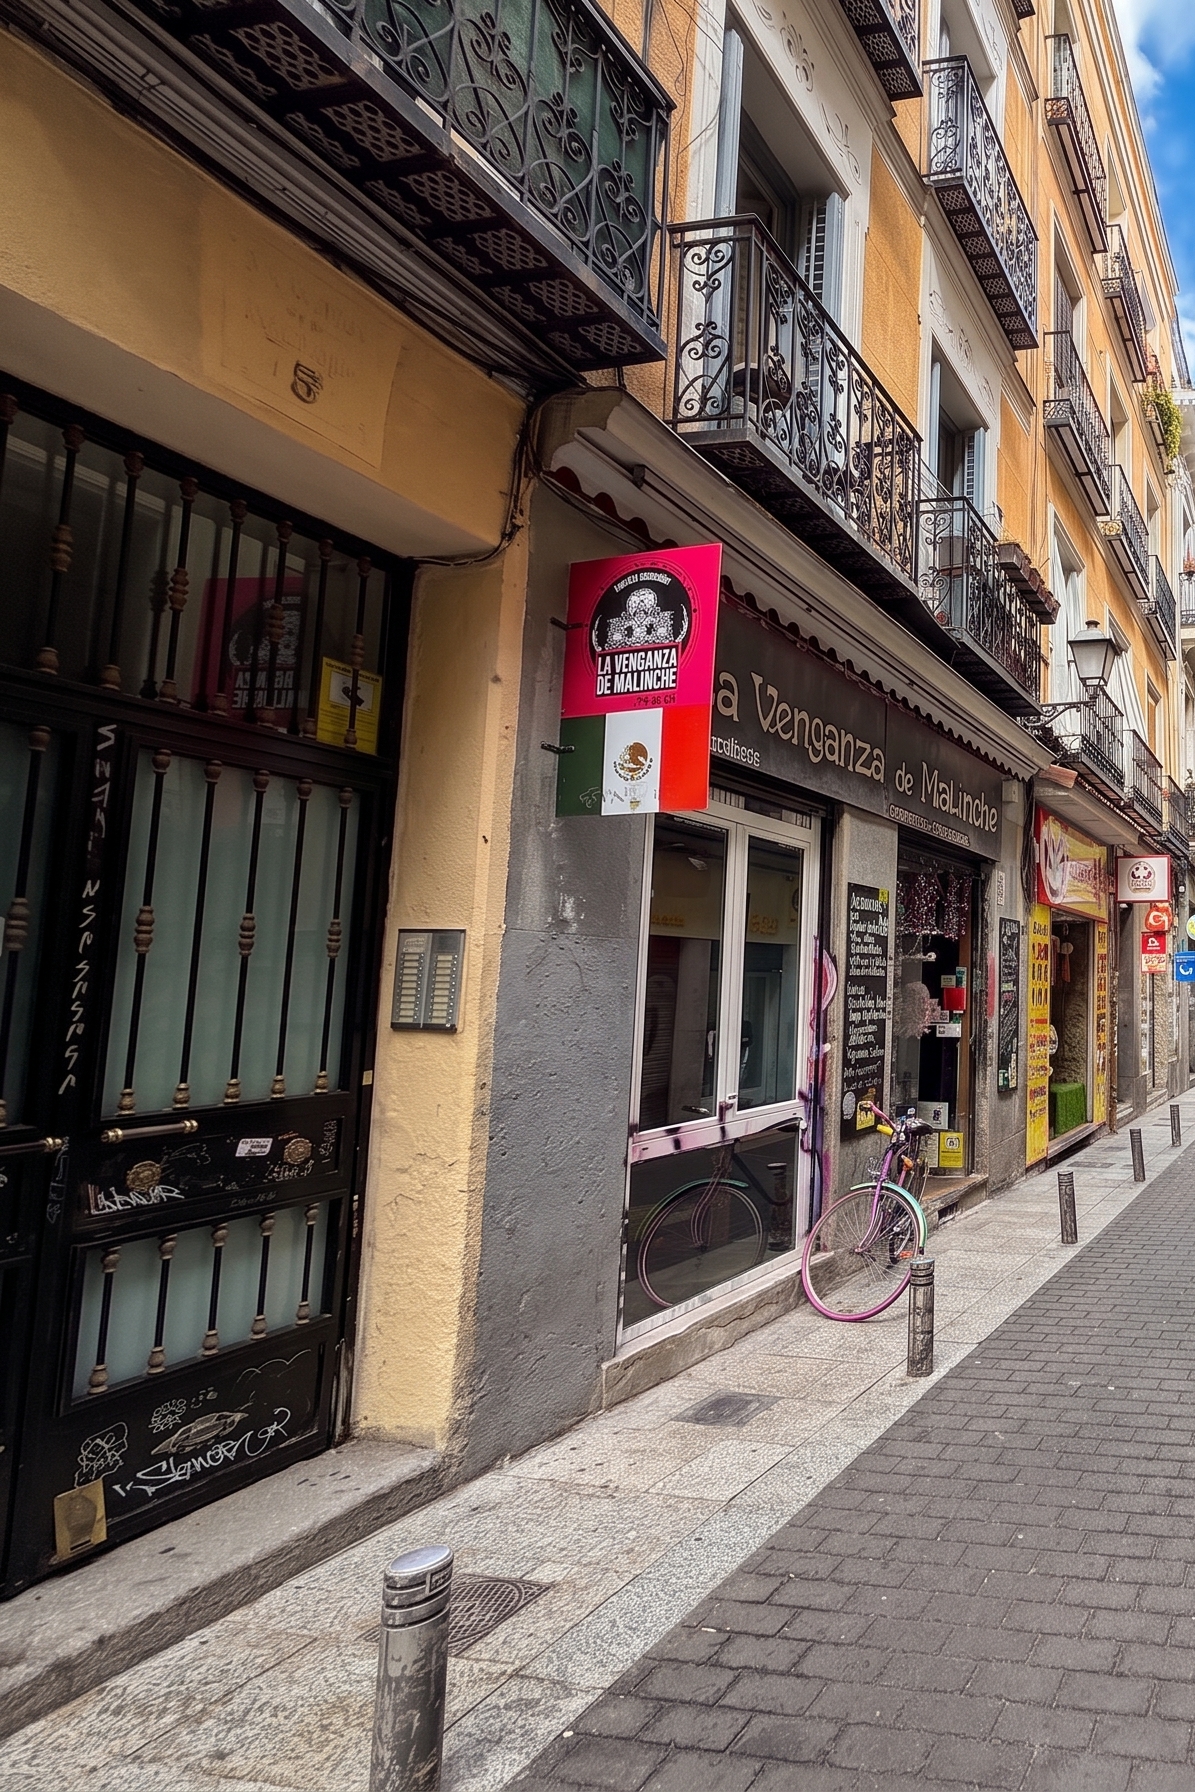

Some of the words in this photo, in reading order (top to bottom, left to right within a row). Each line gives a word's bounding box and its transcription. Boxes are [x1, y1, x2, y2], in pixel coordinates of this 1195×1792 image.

[597, 655, 612, 675] LA
[614, 648, 677, 673] VENGANZA
[596, 675, 611, 695] DE
[613, 668, 677, 694] MALINCHE
[713, 671, 740, 722] a
[750, 671, 885, 783] Venganza
[895, 761, 914, 796] de
